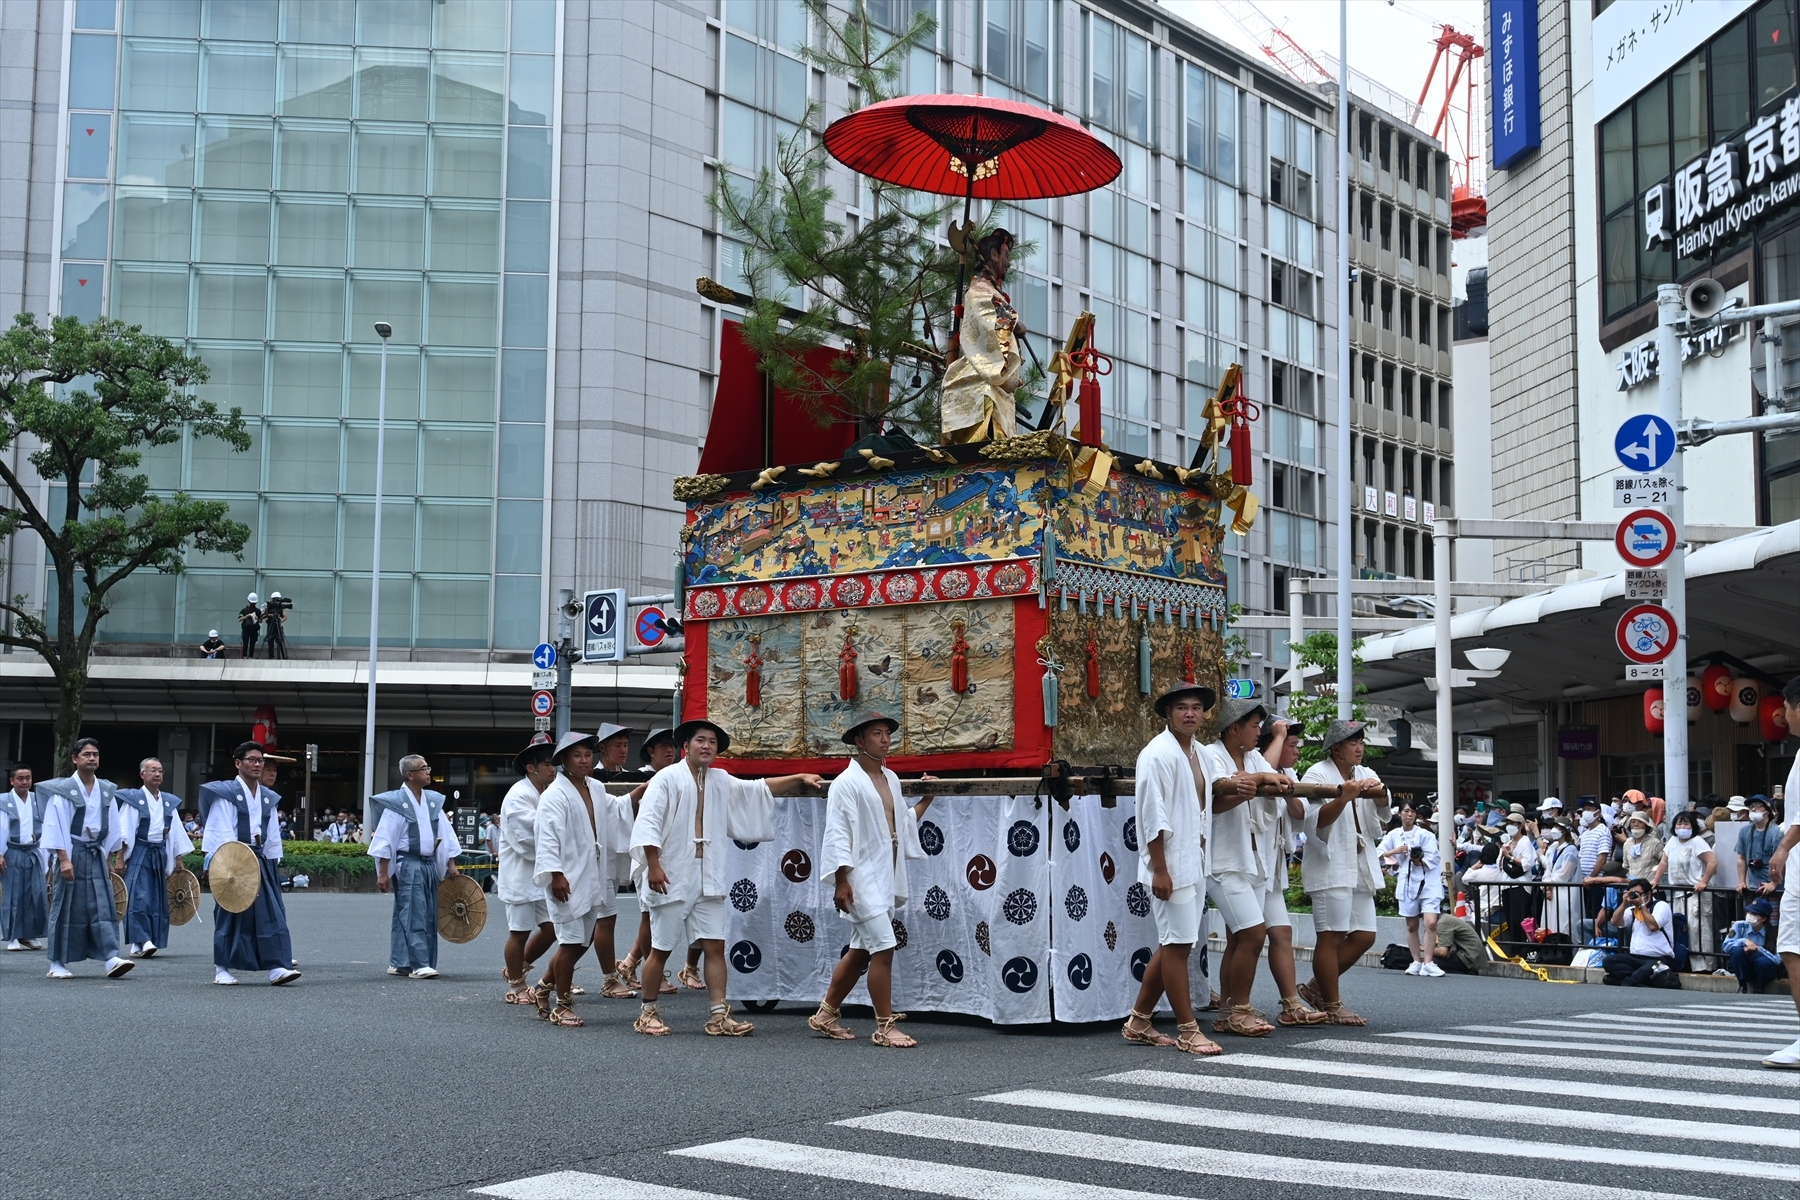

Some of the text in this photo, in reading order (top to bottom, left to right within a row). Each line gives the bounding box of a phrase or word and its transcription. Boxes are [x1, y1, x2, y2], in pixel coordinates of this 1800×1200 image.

[1501, 11, 1515, 137] みずほ銀行
[1677, 217, 1724, 260] Hankyu
[1616, 477, 1674, 490] 路線バスを除く
[1367, 490, 1434, 523] 大和証券
[1627, 579, 1667, 588] マイクロを除く
